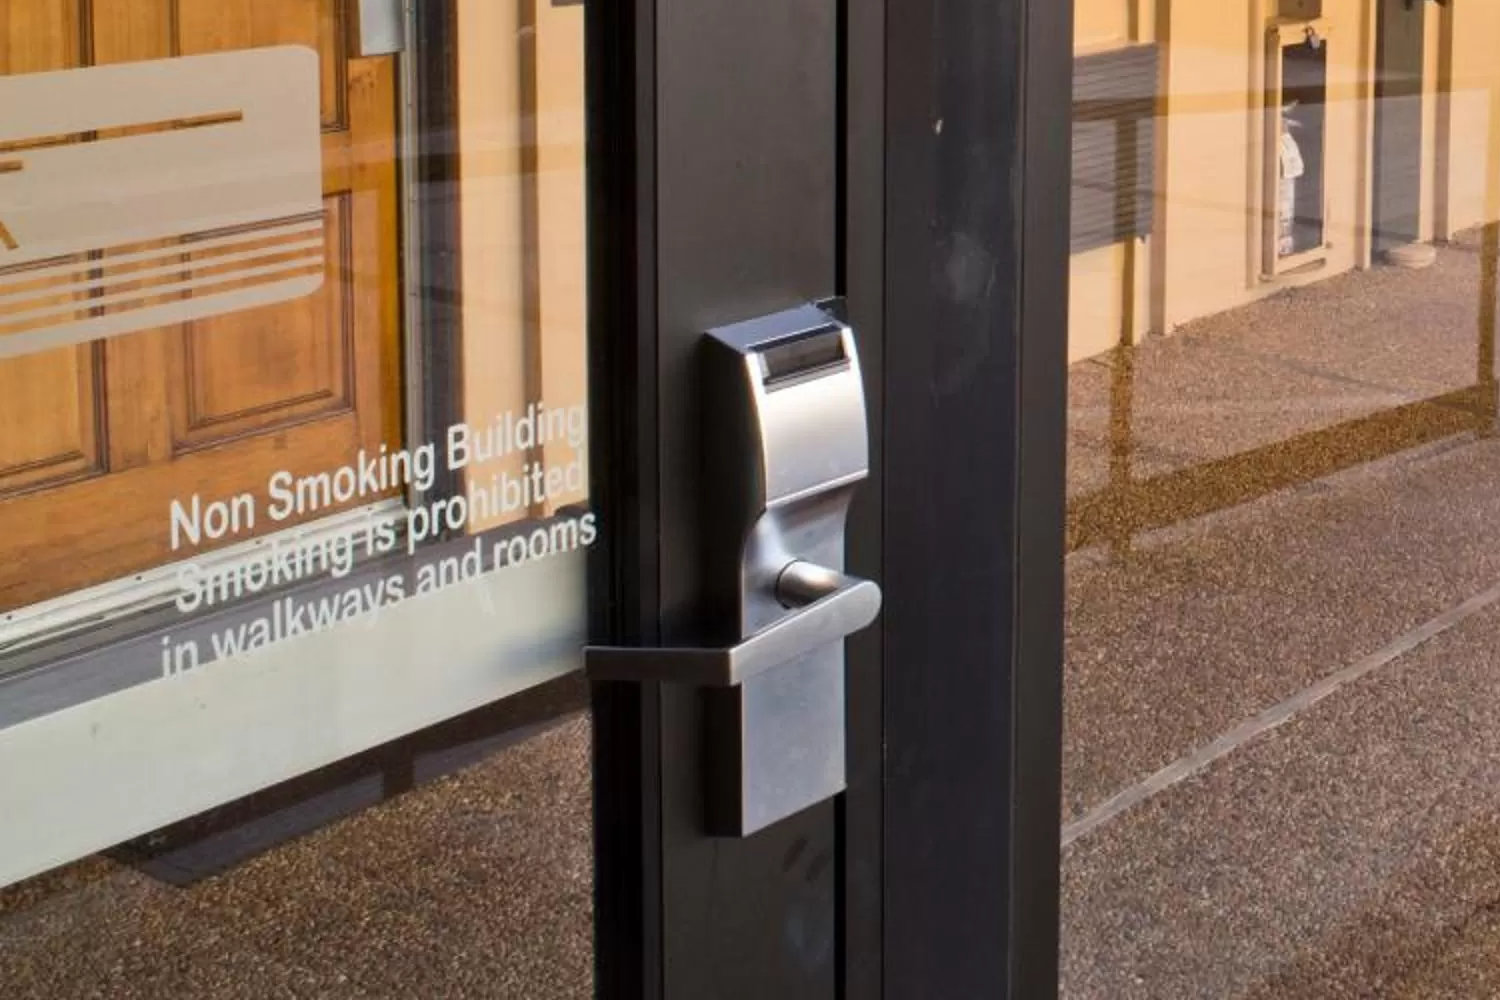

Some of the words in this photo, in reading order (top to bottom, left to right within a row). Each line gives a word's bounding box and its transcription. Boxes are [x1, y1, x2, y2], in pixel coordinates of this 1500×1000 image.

[170, 492, 256, 550] Non
[268, 441, 436, 522] Smoking
[447, 401, 585, 471] Building
[175, 530, 354, 613] Smoking
[364, 512, 395, 556] is
[408, 457, 585, 554] prohibited
[161, 636, 199, 680] in
[211, 574, 405, 662] walkways
[416, 538, 482, 598] and
[493, 511, 597, 568] rooms
